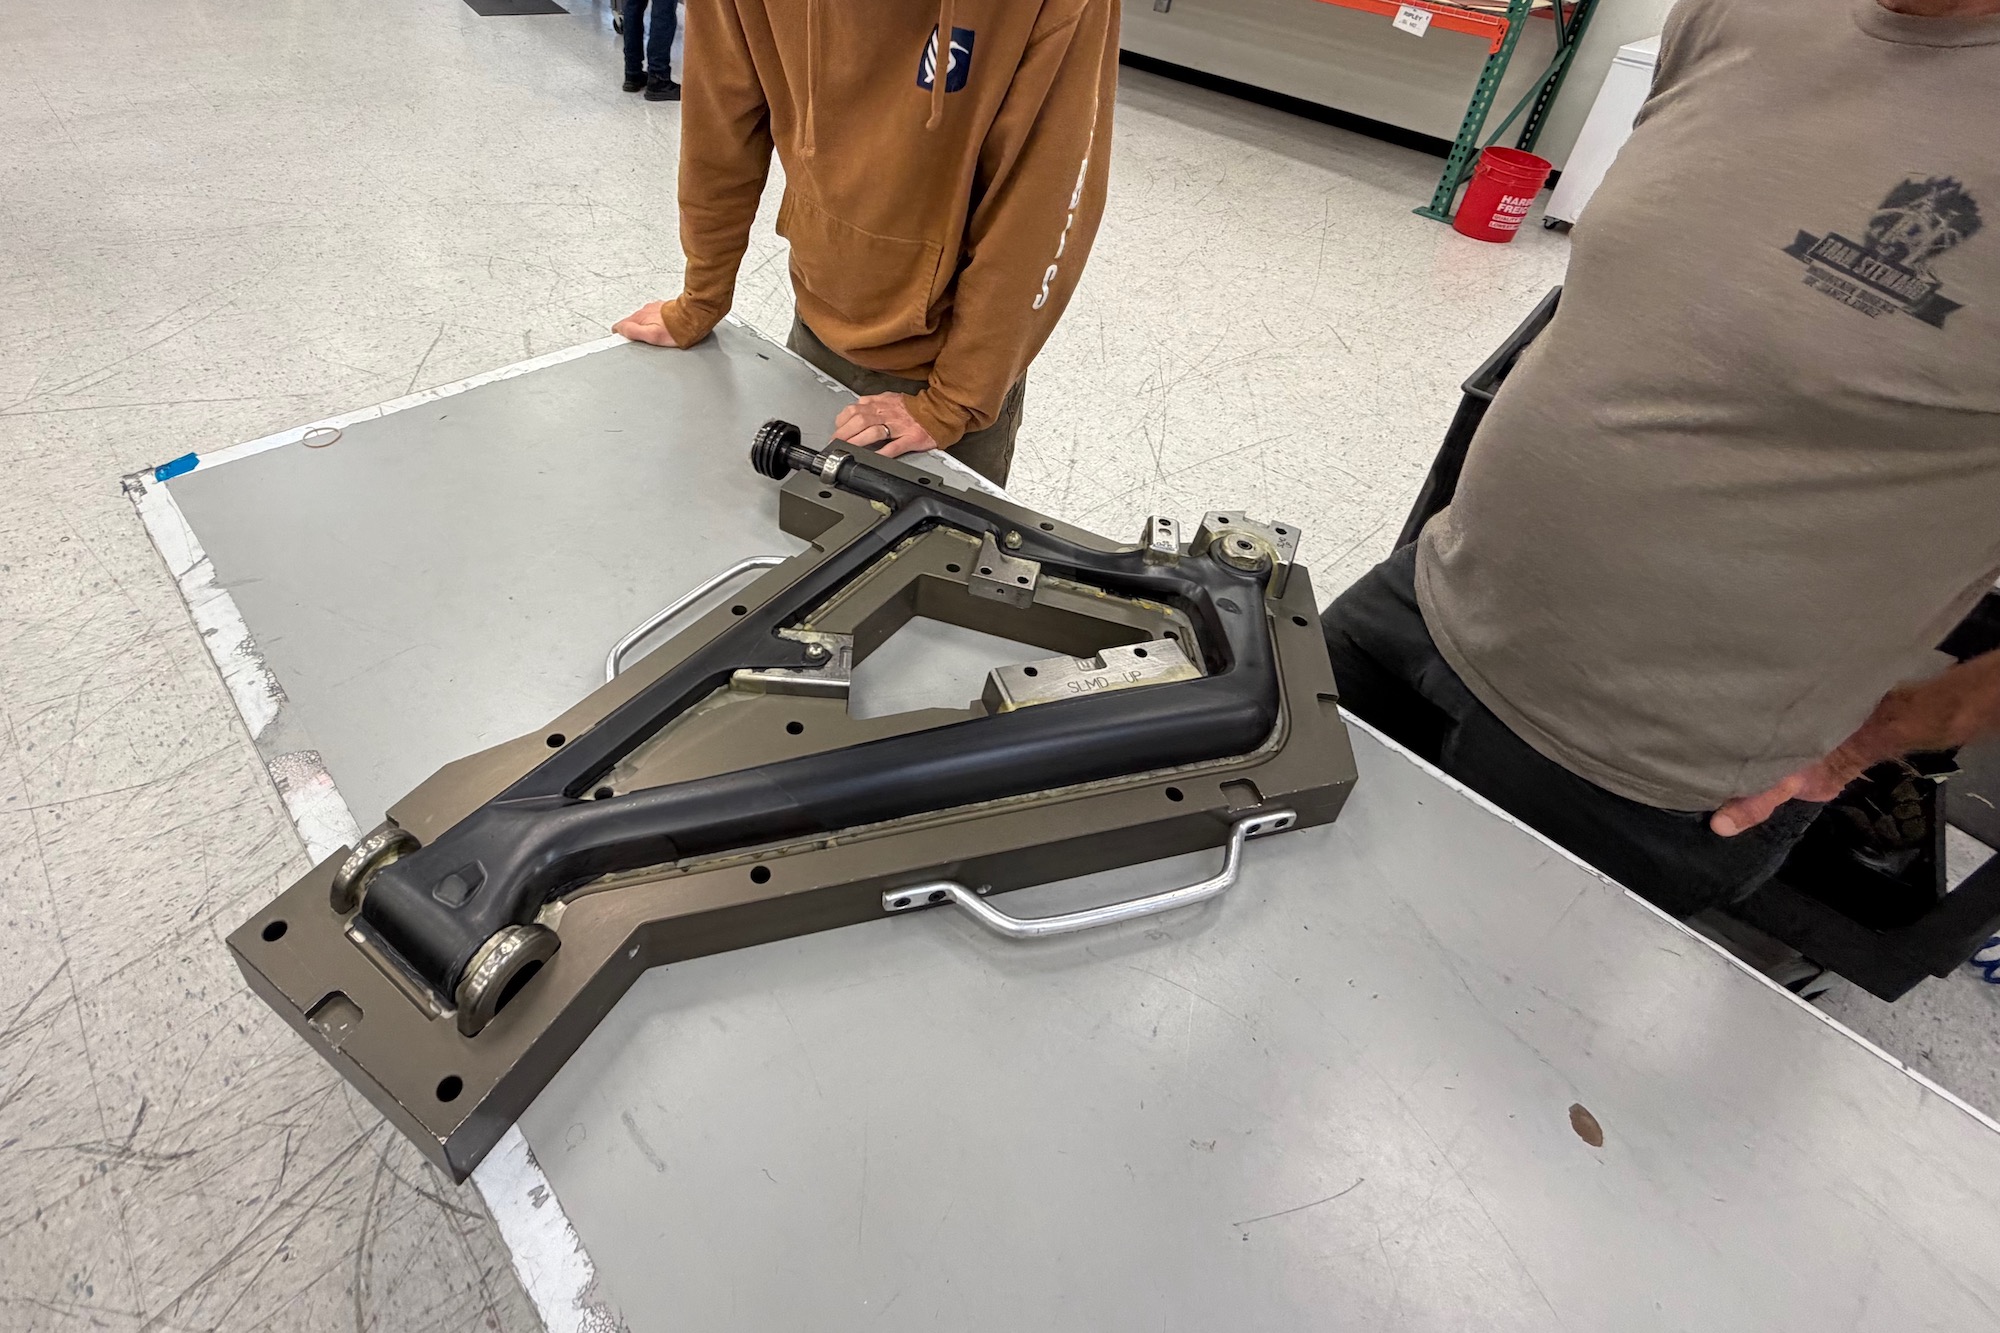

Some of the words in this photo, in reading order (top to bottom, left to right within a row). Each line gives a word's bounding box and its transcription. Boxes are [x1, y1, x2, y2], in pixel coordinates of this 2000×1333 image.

[1500, 195, 1534, 206] HARB
[1067, 676, 1110, 693] SLMD
[1122, 670, 1142, 684] UP
